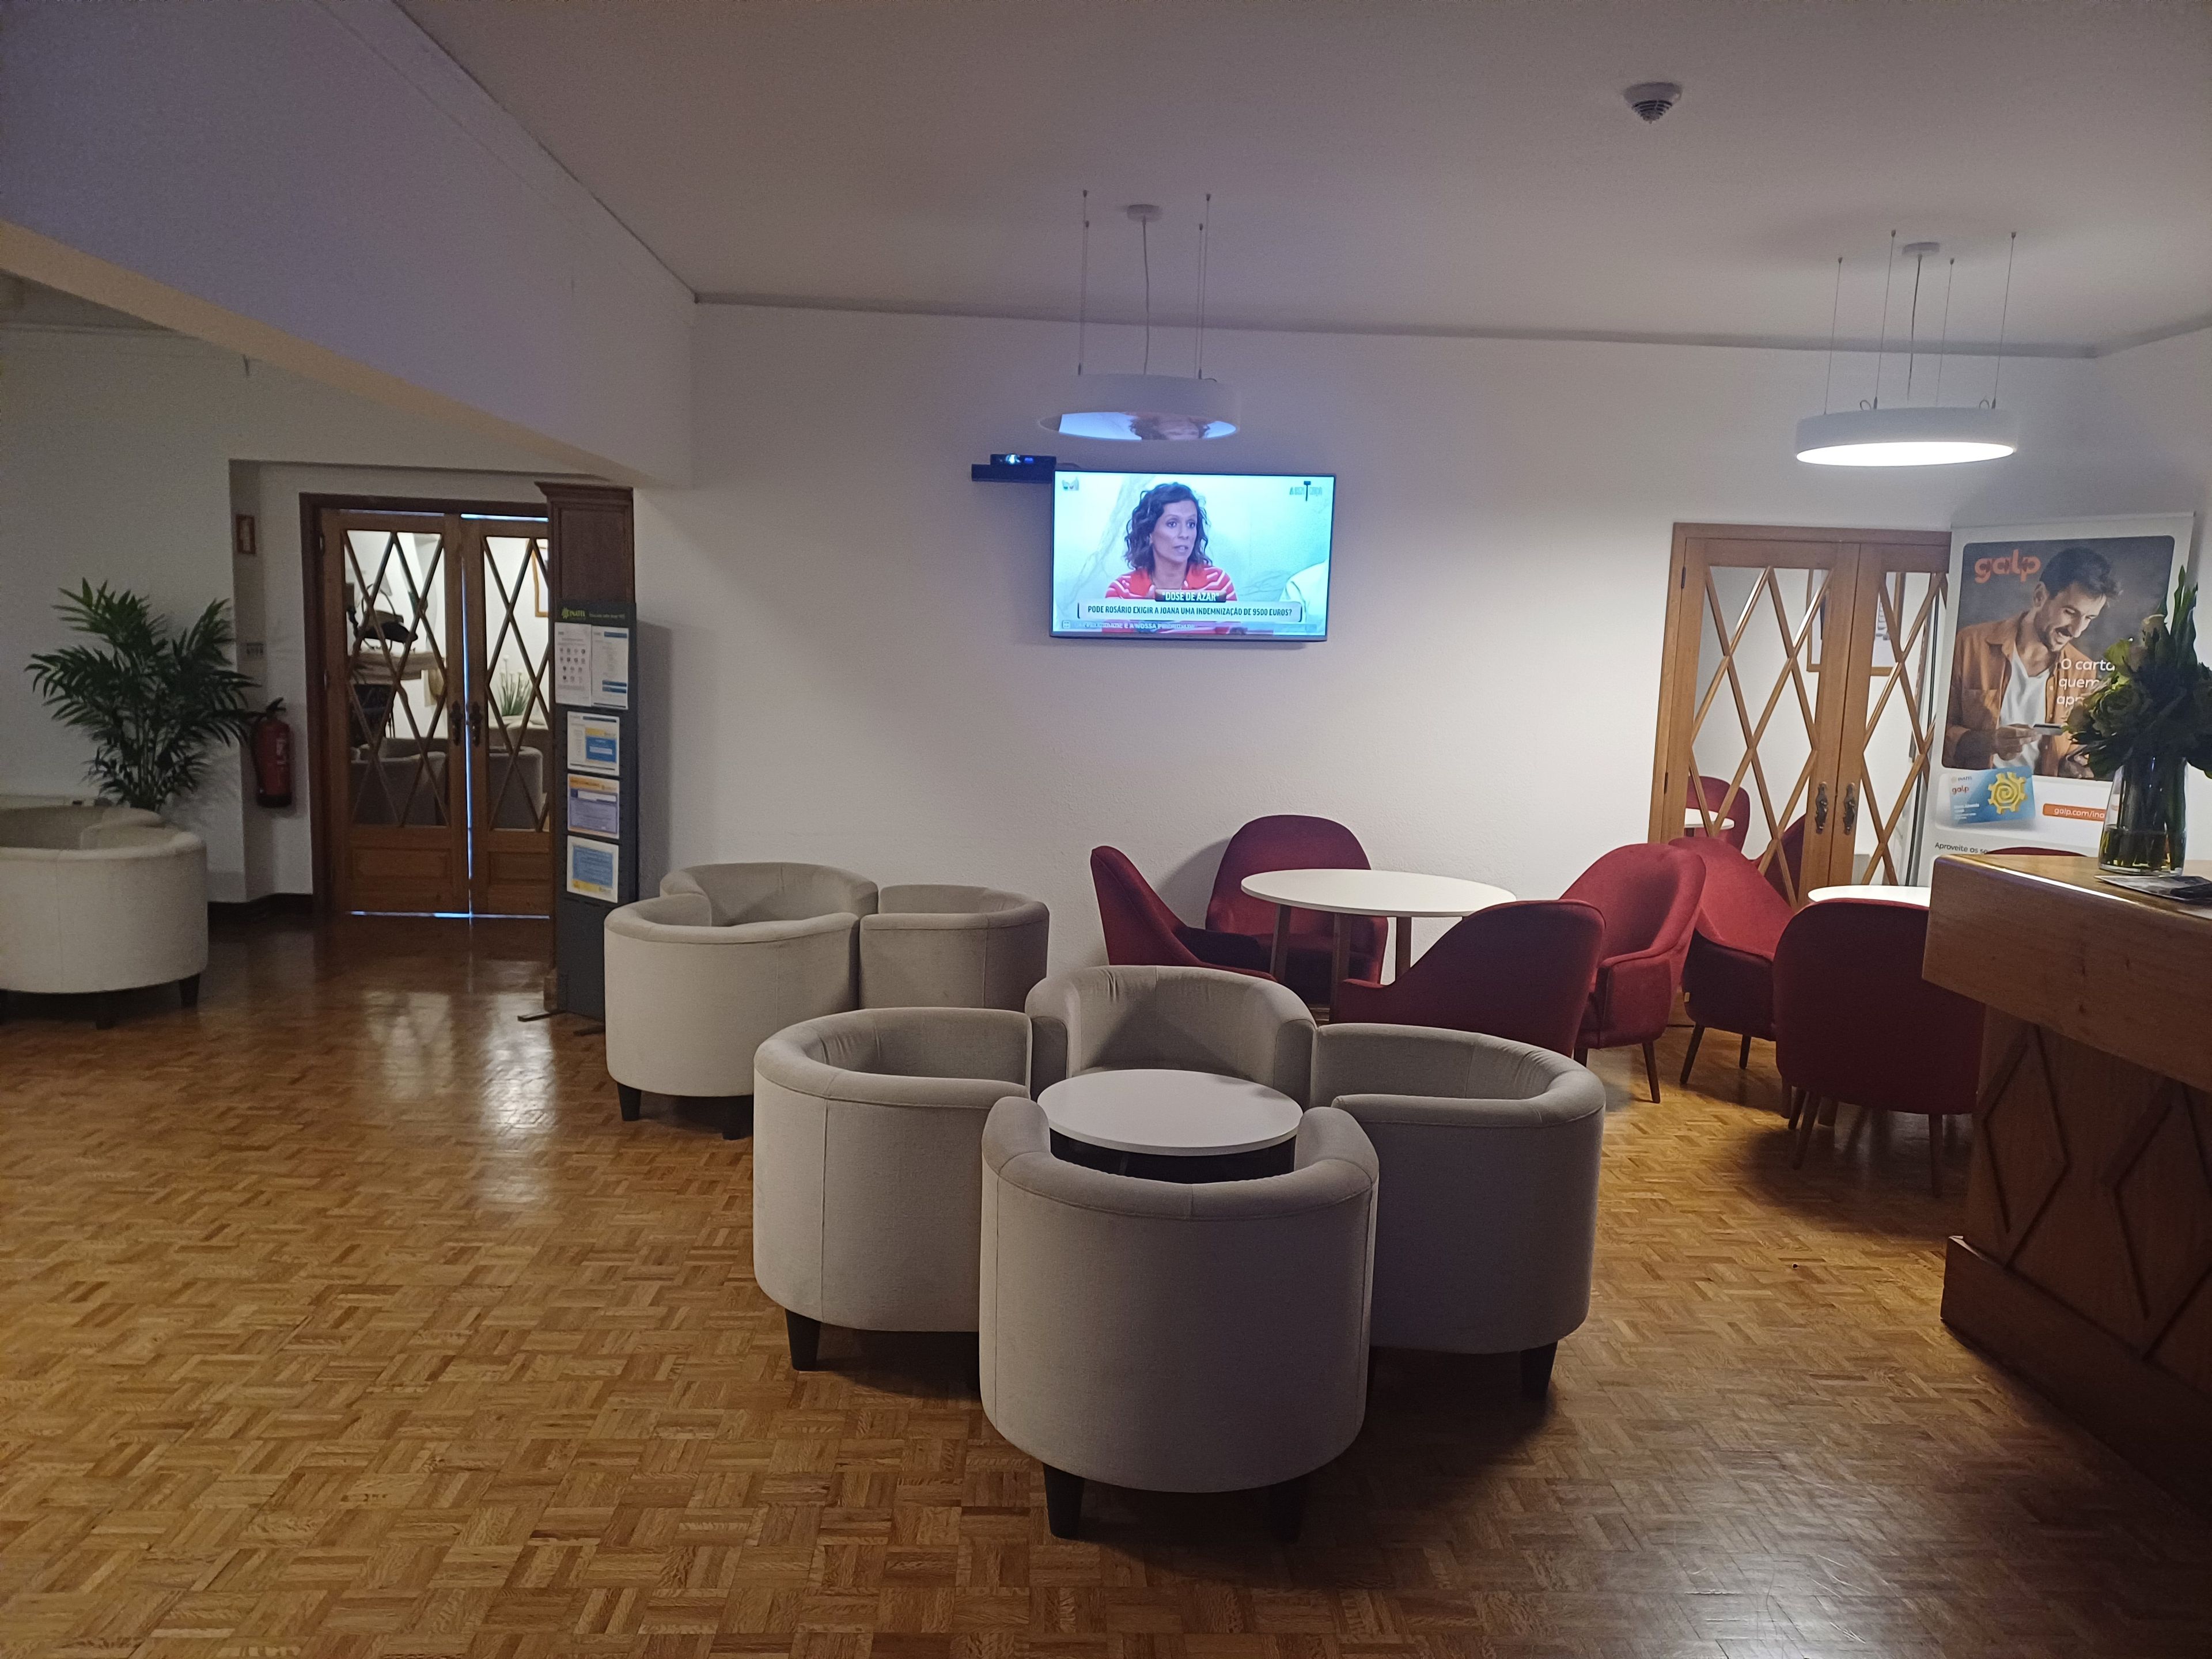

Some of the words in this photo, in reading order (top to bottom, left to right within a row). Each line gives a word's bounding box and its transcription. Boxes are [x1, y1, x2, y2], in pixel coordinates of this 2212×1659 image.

[1975, 549, 2041, 584] galp
[1162, 591, 1184, 601] "DOSE
[1185, 592, 1195, 601] DE
[1196, 592, 1219, 601] AZAR"
[1105, 605, 1131, 613] ROSÁRIO
[1160, 607, 1179, 615] JOANA
[1196, 607, 1243, 616] INDEMNIZAÇÃO
[1252, 608, 1268, 616] 9500
[2061, 658, 2072, 670] O
[1952, 785, 1969, 795] galp
[2054, 808, 2105, 819] galp.com/ina
[1935, 842, 1968, 852] Aproveite
